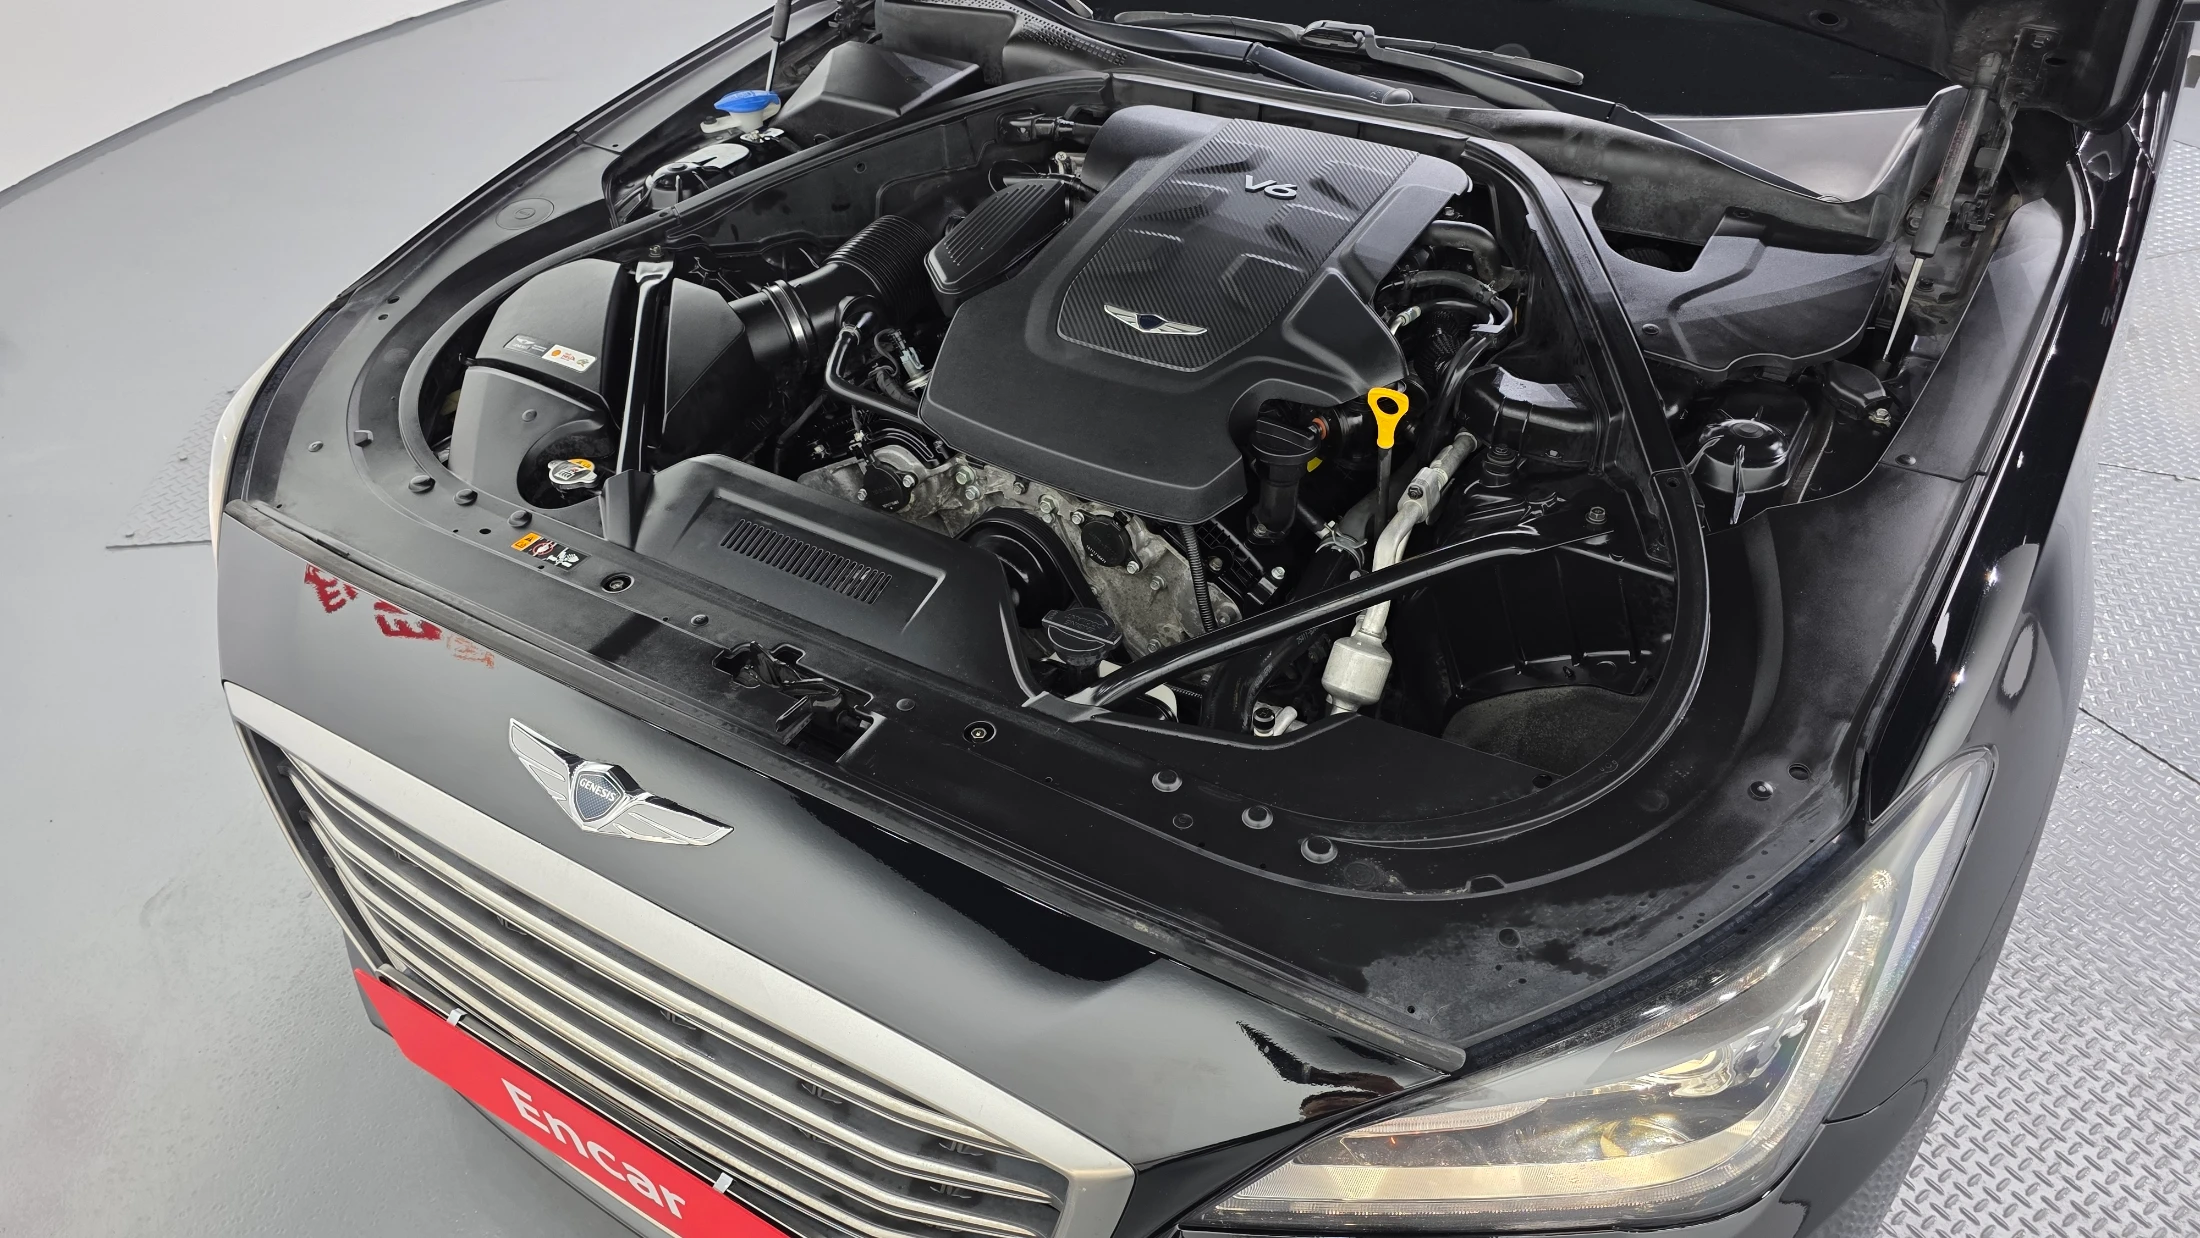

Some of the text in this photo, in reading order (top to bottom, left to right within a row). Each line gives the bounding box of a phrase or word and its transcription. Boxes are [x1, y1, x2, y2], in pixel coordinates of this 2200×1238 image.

[1245, 174, 1297, 200] V6
[579, 778, 616, 802] GENESIS
[501, 1077, 686, 1219] Encar
